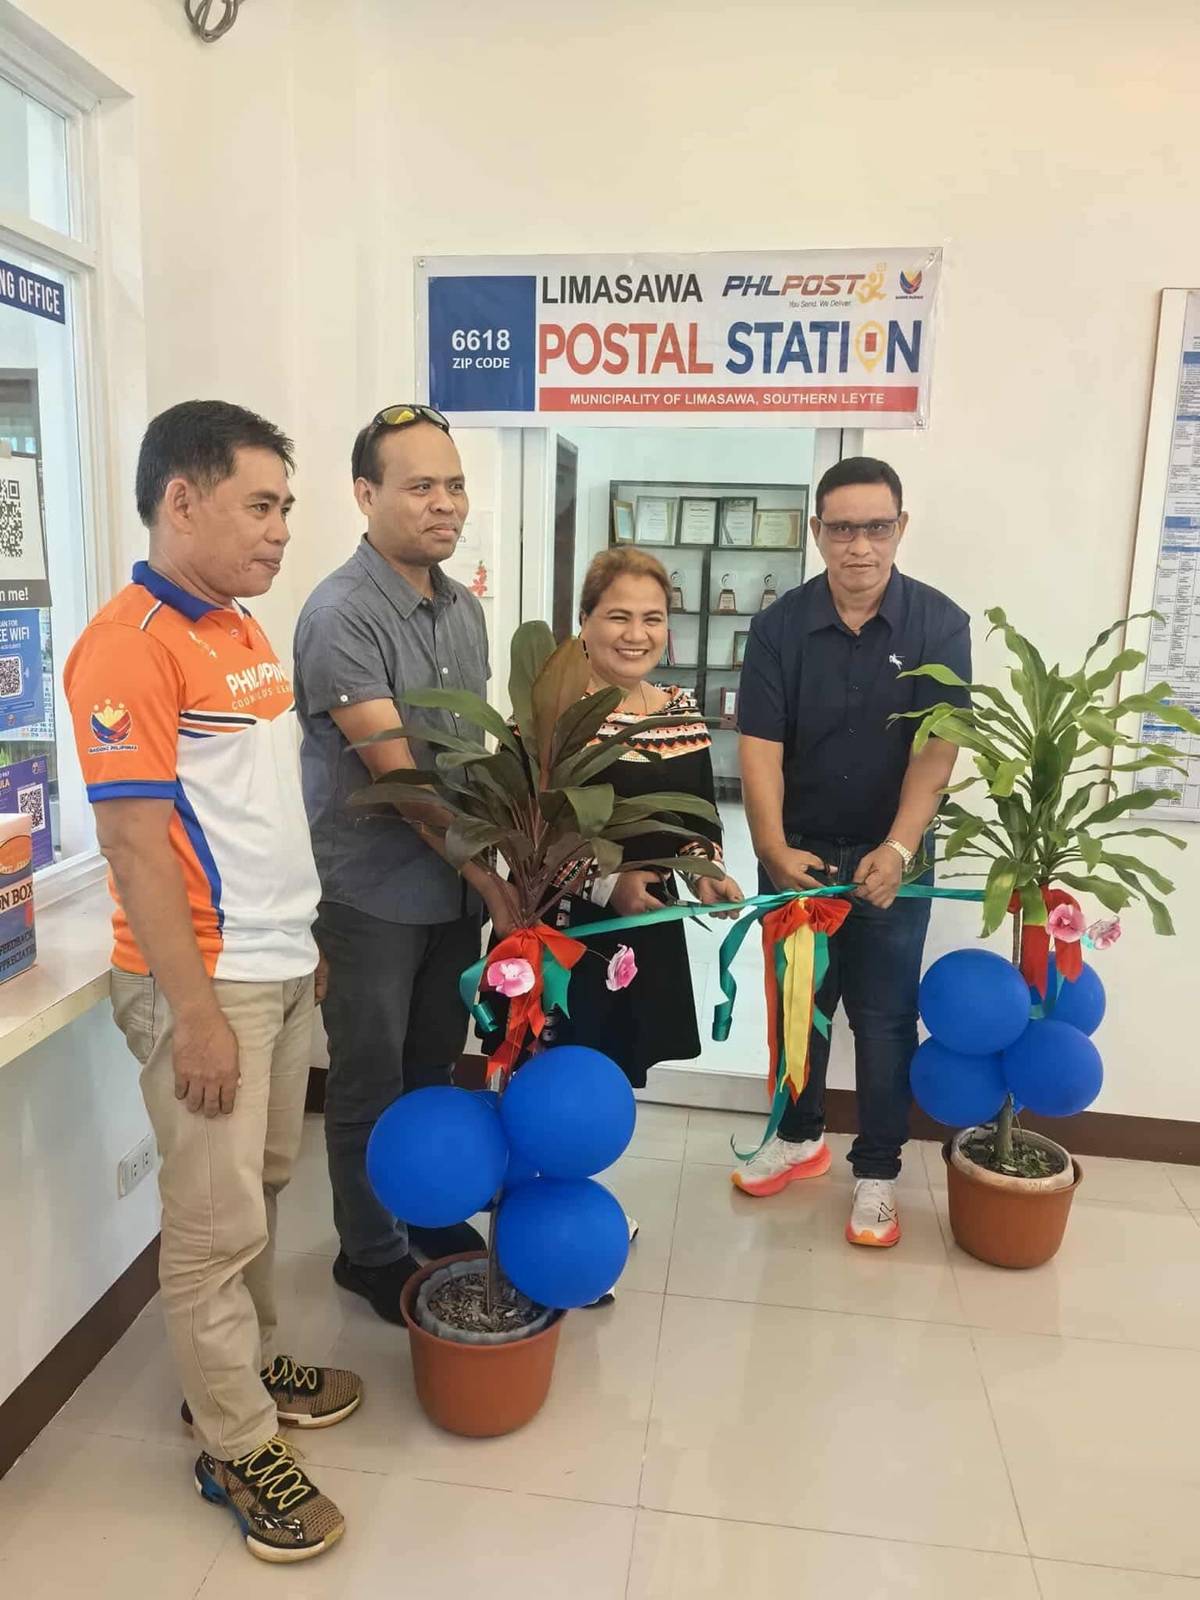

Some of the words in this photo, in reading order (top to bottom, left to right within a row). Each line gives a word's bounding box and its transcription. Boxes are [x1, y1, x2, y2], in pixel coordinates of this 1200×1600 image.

[19, 275, 61, 315] OFFICE
[542, 273, 703, 304] LIMASAWA
[722, 274, 866, 297] PHLPOST
[789, 300, 799, 308] You
[451, 329, 511, 351] 6618
[538, 322, 713, 375] POSTAL
[725, 319, 923, 374] STATION
[452, 357, 473, 369] ZIP
[475, 357, 511, 369] CODE
[570, 393, 660, 405] MUNICIPALITY
[663, 393, 681, 405] OF
[684, 392, 759, 406] LIMASAWA,
[763, 392, 837, 404] SOUTHERN
[841, 392, 885, 404] LEYTE
[8, 587, 29, 601] me!
[9, 626, 30, 641] WIFI
[11, 880, 34, 906] BOX
